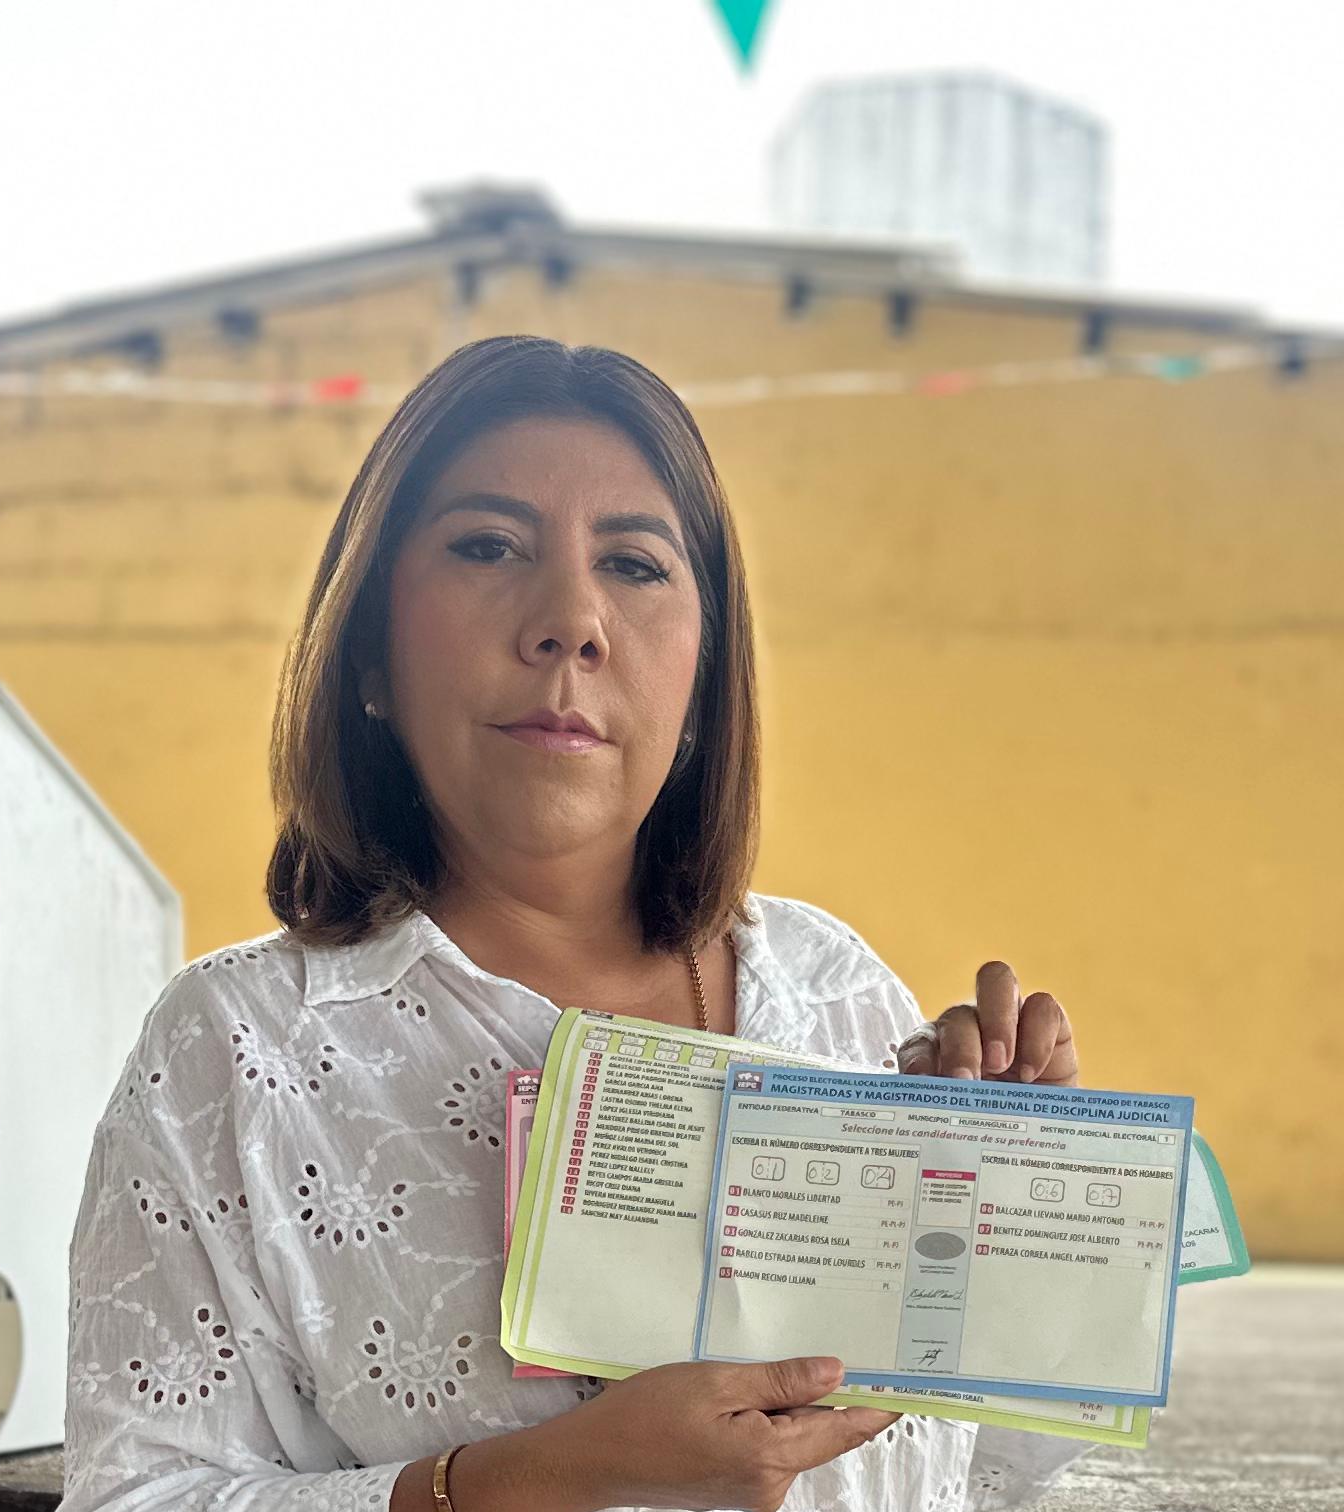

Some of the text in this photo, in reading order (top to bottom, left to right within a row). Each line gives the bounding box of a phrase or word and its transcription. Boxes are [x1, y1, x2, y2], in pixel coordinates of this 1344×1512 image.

[773, 1074, 808, 1082] PROCESO
[809, 1076, 852, 1086] ELECTORAL
[854, 1079, 878, 1088] LOCAL
[990, 1089, 1005, 1097] DEL
[1007, 1090, 1034, 1099] PODER
[1034, 1092, 1069, 1102] JUDICIAL
[1071, 1095, 1086, 1103] DEL
[1087, 1096, 1119, 1105] ESTADO
[1133, 1100, 1170, 1109] TABASCO
[771, 1083, 1169, 1122] MAGISTRADAS Y MAGISTRADOS DEL TRIBUNAL DE DISCIPLINA JUDICIAL
[737, 1103, 772, 1111] ENTIDAD
[772, 1105, 819, 1115] FEDERATIVA
[841, 1110, 876, 1119] TABASCO
[908, 1115, 949, 1124] MUNICIPIO
[1040, 1126, 1076, 1136] DISTRITO
[1077, 1129, 1111, 1138] JUDICIAL
[1113, 1132, 1157, 1142] ELECTORAL
[841, 1124, 894, 1136] Seleccione
[896, 1128, 910, 1137] las
[912, 1129, 978, 1142] candidaturas
[981, 1134, 993, 1143] de
[1008, 1137, 1066, 1149] preferencia
[732, 1137, 759, 1146] ESCRIBA
[761, 1139, 768, 1147] EL
[870, 1147, 887, 1156] TRES
[888, 1148, 919, 1158] MUJERES
[982, 1156, 1009, 1166] ESCRIBA
[1011, 1158, 1018, 1166] EL
[1123, 1168, 1138, 1177] DOS
[1139, 1169, 1173, 1180] HOMBRES
[743, 1189, 771, 1198] BLANCO
[772, 1191, 806, 1201] MORALES
[807, 1194, 841, 1203] LIBERTAD
[741, 1209, 772, 1219] CASASUS
[789, 1213, 829, 1224] MADELEINE
[995, 1206, 1033, 1217] BALCAZAR
[1034, 1209, 1065, 1220] LIEVANO
[1066, 1213, 1091, 1223] MARIO
[1092, 1215, 1125, 1226] ANTONIO
[738, 1229, 774, 1240] GONZALEZ
[775, 1232, 809, 1243] ZACARIAS
[811, 1235, 829, 1245] ROSA
[831, 1237, 850, 1246] ISELA
[993, 1226, 1023, 1237] BENITEZ
[1024, 1229, 1068, 1241] DOMINGUEZ
[1069, 1233, 1086, 1243] JOSE
[1087, 1234, 1120, 1246] ALBERTO
[764, 1252, 796, 1262] ESTRADA
[797, 1254, 821, 1264] MARIA
[822, 1256, 832, 1265] DE
[990, 1246, 1019, 1257] PERAZA
[1020, 1249, 1049, 1259] CORREA
[1050, 1252, 1073, 1261] ANGEL
[1074, 1254, 1109, 1264] ANTONIO
[733, 1269, 760, 1280] RAMON
[761, 1272, 787, 1283] RECINO
[788, 1275, 816, 1285] LILIANA
